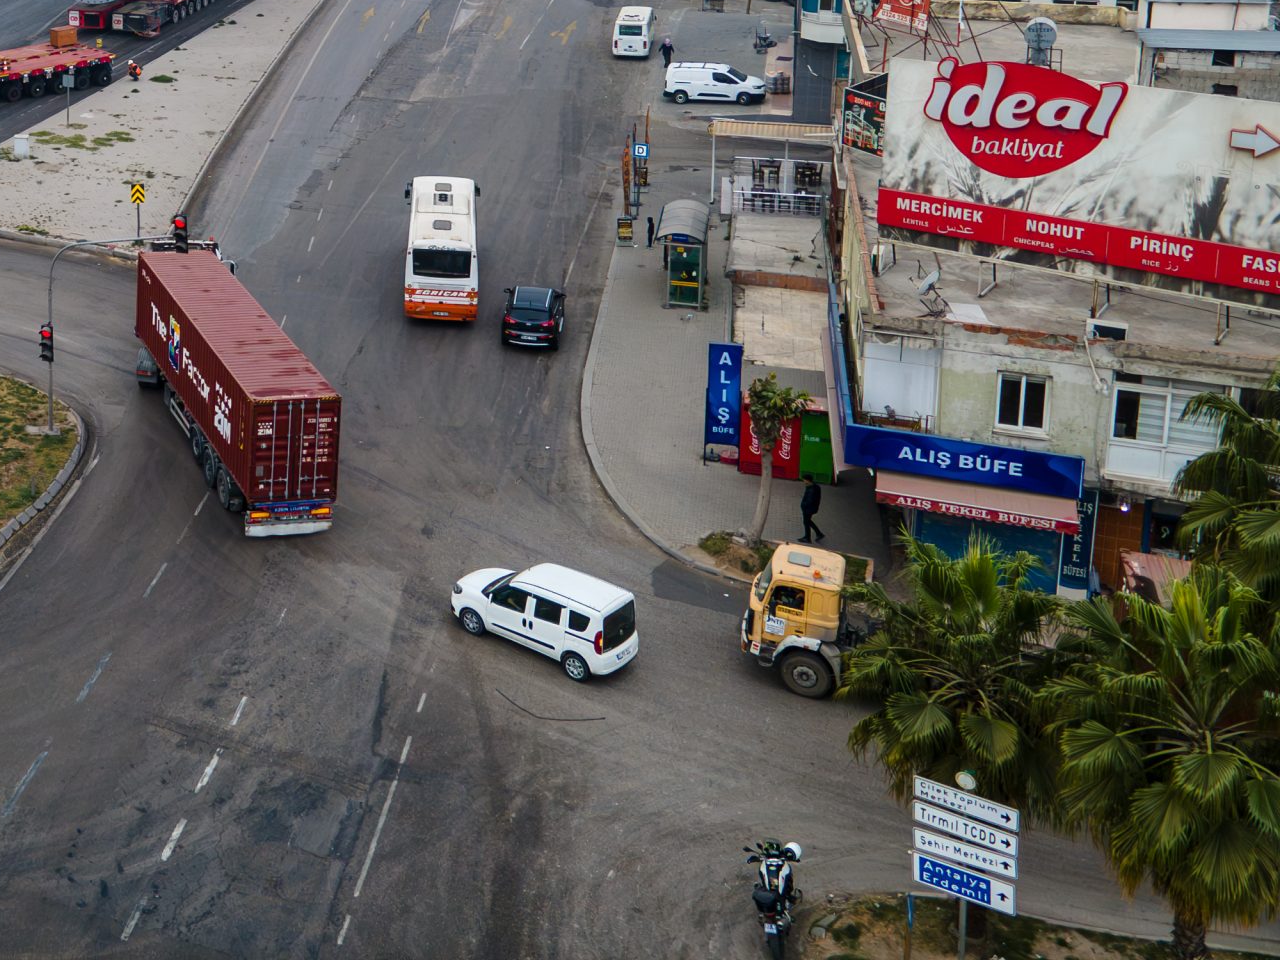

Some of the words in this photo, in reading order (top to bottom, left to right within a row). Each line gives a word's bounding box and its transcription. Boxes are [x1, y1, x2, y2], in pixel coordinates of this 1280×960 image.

[924, 57, 1127, 138] ideal
[971, 136, 1064, 162] bakliyat
[896, 197, 984, 223] MERCİMEK
[902, 217, 929, 228] LENTILS
[937, 224, 974, 234] عدس
[1026, 219, 1084, 240] NOHUT
[1014, 237, 1055, 249] CHICKPEAS
[1130, 235, 1194, 262] PİRİNÇ
[1142, 259, 1160, 267] RICE
[1165, 260, 1179, 272] رز
[1242, 255, 1280, 273] FAS
[1243, 276, 1270, 286] BEANS
[151, 301, 167, 342] The
[182, 347, 210, 404] Factor
[717, 351, 732, 424] ALIŞ
[712, 426, 734, 434] BÜFE
[898, 446, 951, 468] ALIŞ
[959, 454, 1023, 477] BÜFE
[896, 496, 932, 510] ALIŞ
[939, 503, 990, 519] TEKEL
[1063, 564, 1087, 578] BÜFESİ
[920, 790, 967, 811] Merkezi
[953, 792, 998, 813] Toplum
[920, 807, 959, 832] Tırmıl
[962, 823, 996, 845] TCDD
[920, 835, 950, 851] Şehir
[954, 846, 998, 867] Merkezi
[924, 861, 987, 889] Antalya
[922, 872, 988, 902] Erdemli
